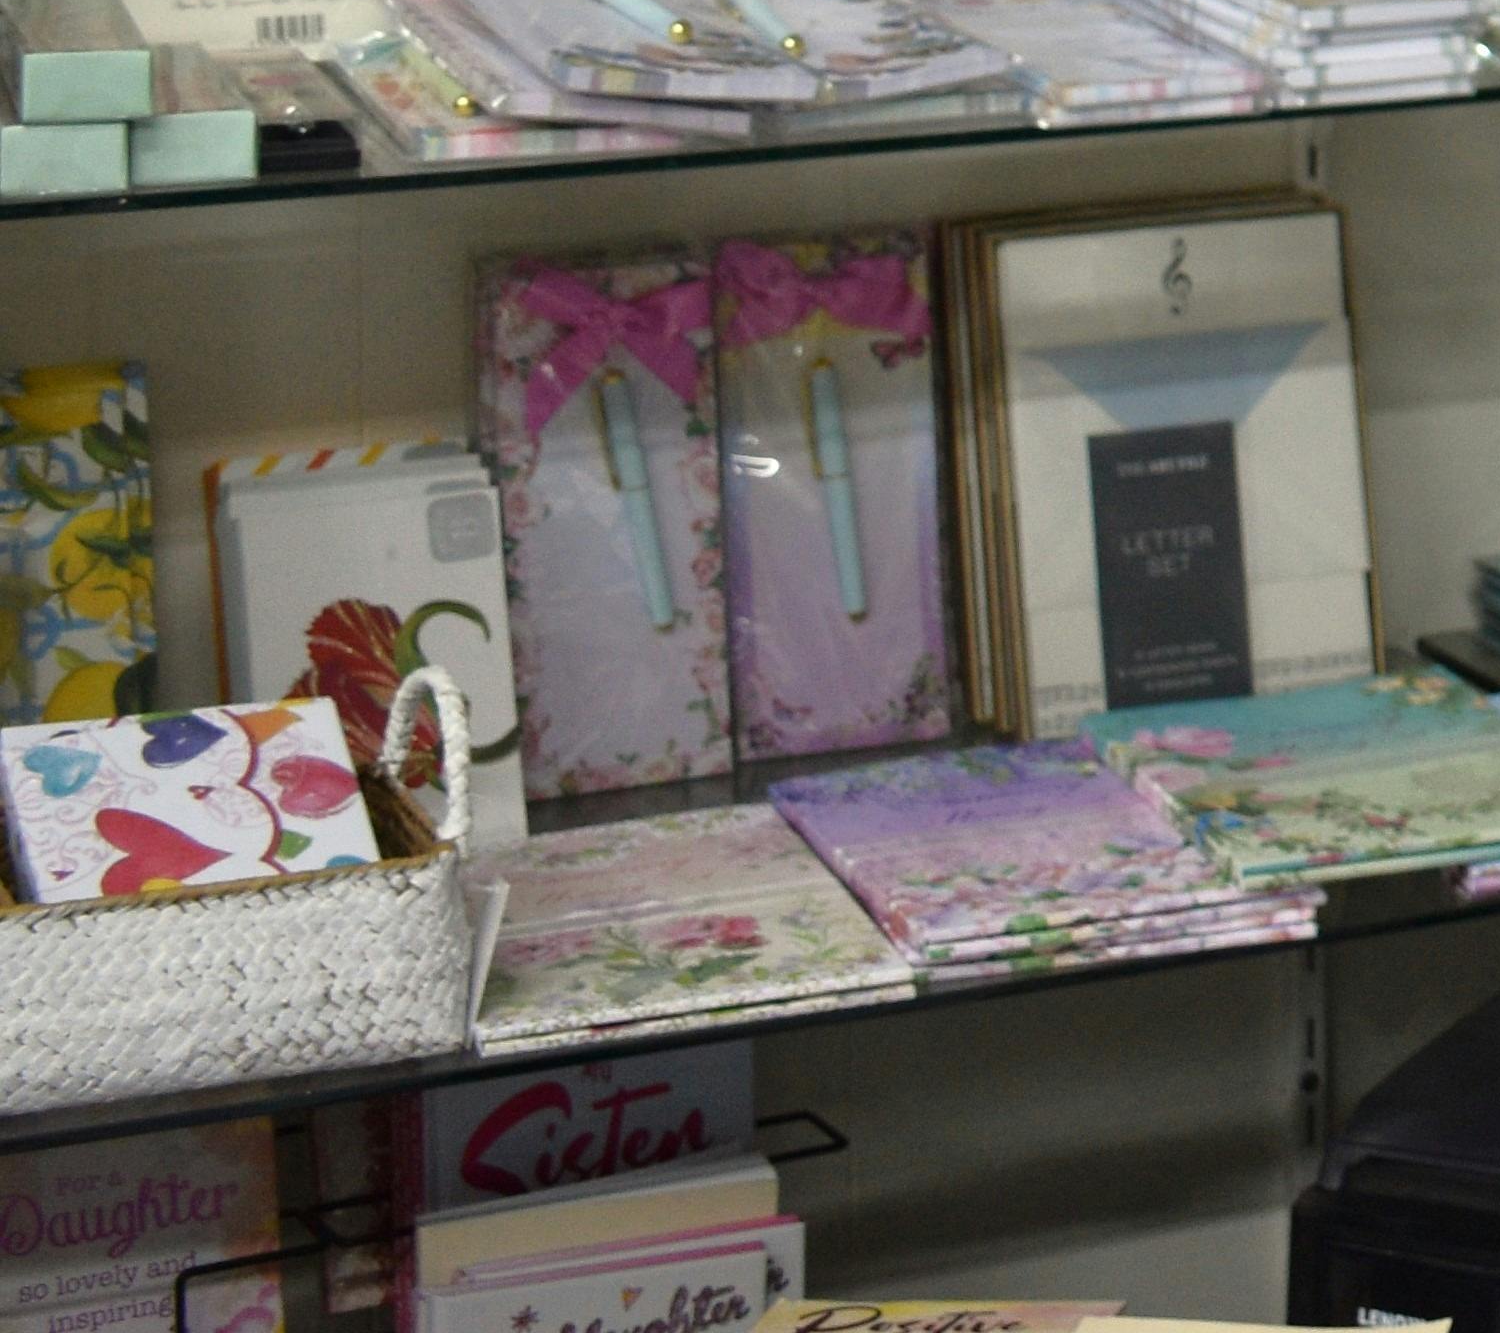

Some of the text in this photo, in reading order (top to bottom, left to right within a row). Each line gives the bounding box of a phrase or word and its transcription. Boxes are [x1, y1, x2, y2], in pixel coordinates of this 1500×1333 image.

[54, 1171, 127, 1196] For a
[0, 1173, 240, 1259] Daughter
[18, 1249, 198, 1305] so lovely and
[47, 1293, 175, 1333] inspiring
